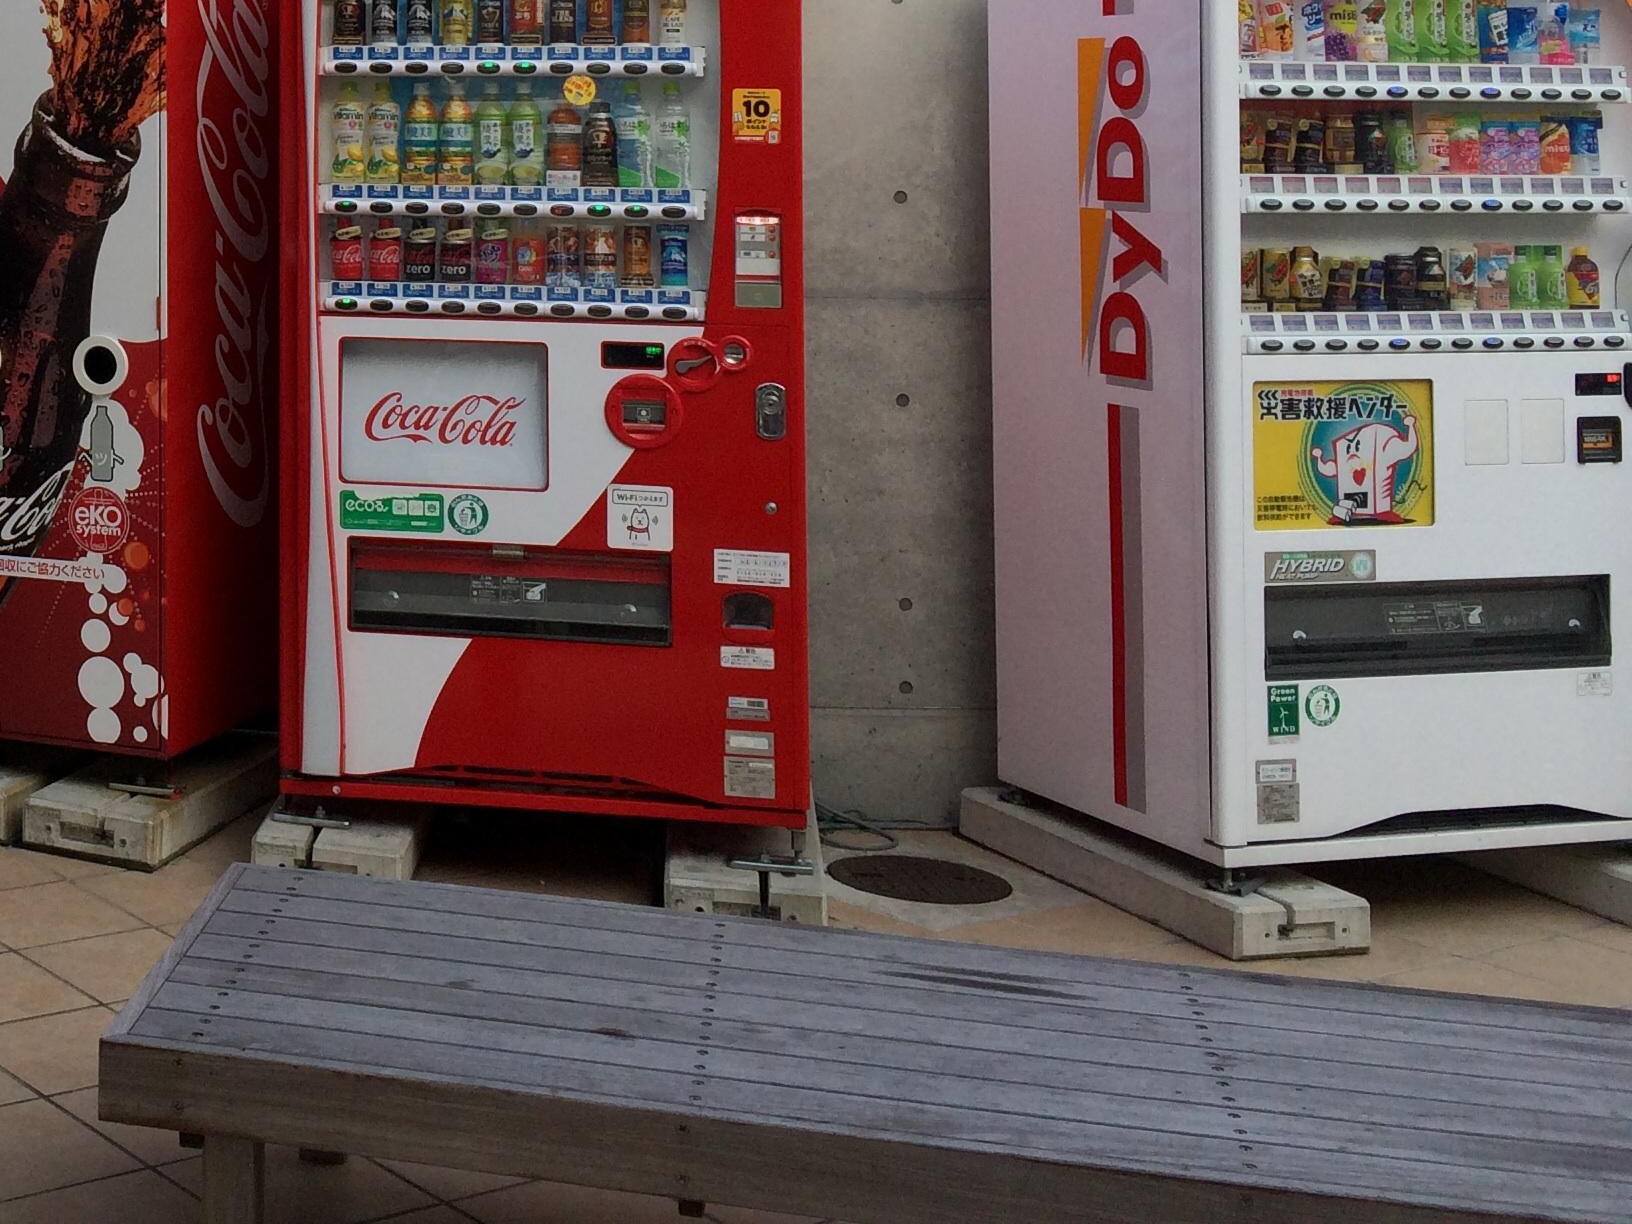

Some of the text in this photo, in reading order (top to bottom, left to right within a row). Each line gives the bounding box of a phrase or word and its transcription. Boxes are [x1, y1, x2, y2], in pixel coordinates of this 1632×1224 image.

[742, 100, 770, 118] 10
[1097, 35, 1163, 382] DyDo
[406, 264, 431, 274] zero
[441, 265, 466, 275] zero
[1258, 389, 1408, 421] 災害救援ベンダー
[365, 392, 526, 447] Coca-Cola
[76, 524, 121, 537] system
[1270, 558, 1345, 579] HYBRID
[1271, 687, 1295, 695] Green
[1273, 725, 1296, 733] WIND
